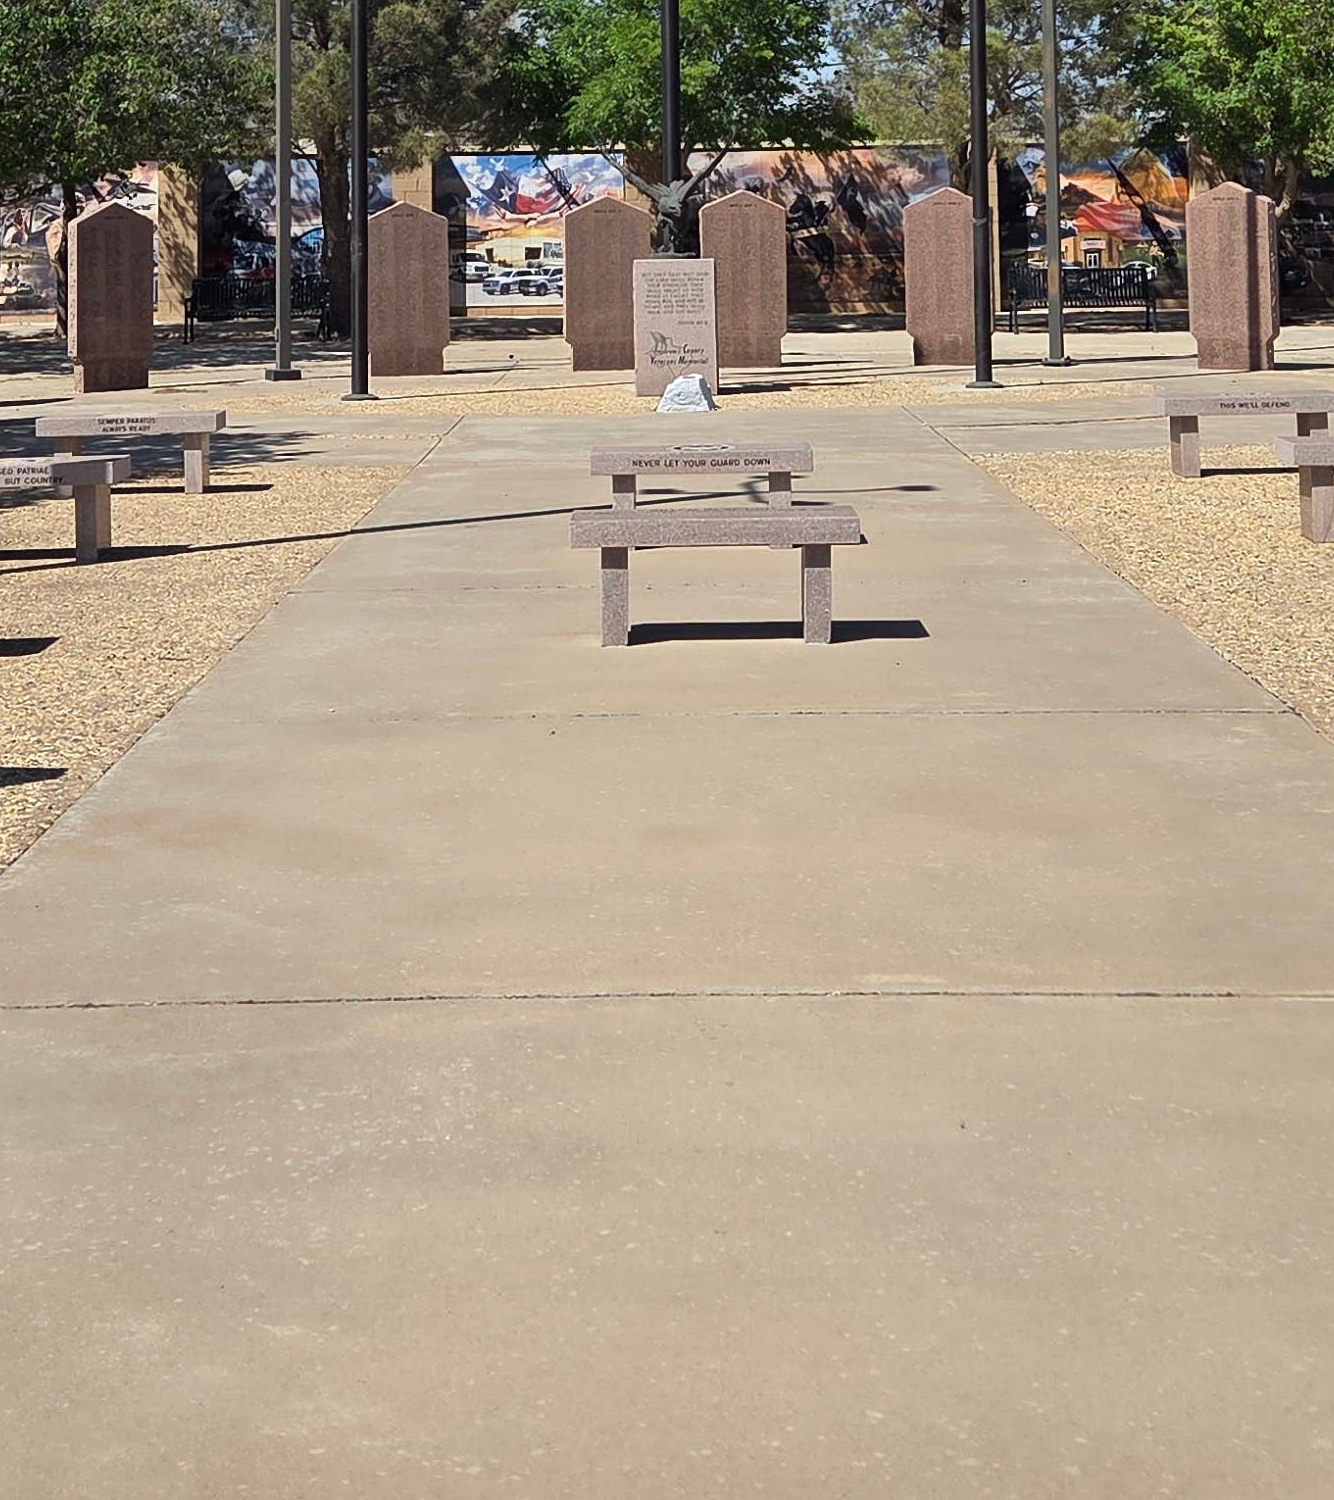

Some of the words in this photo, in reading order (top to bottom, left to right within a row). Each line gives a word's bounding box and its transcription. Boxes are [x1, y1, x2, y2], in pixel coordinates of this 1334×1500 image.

[711, 459, 741, 467] GUARD
[744, 458, 771, 467] DOWN
[17, 466, 49, 475] PATRIAE
[5, 477, 21, 485] BUT
[25, 476, 63, 484] COUNTRY
